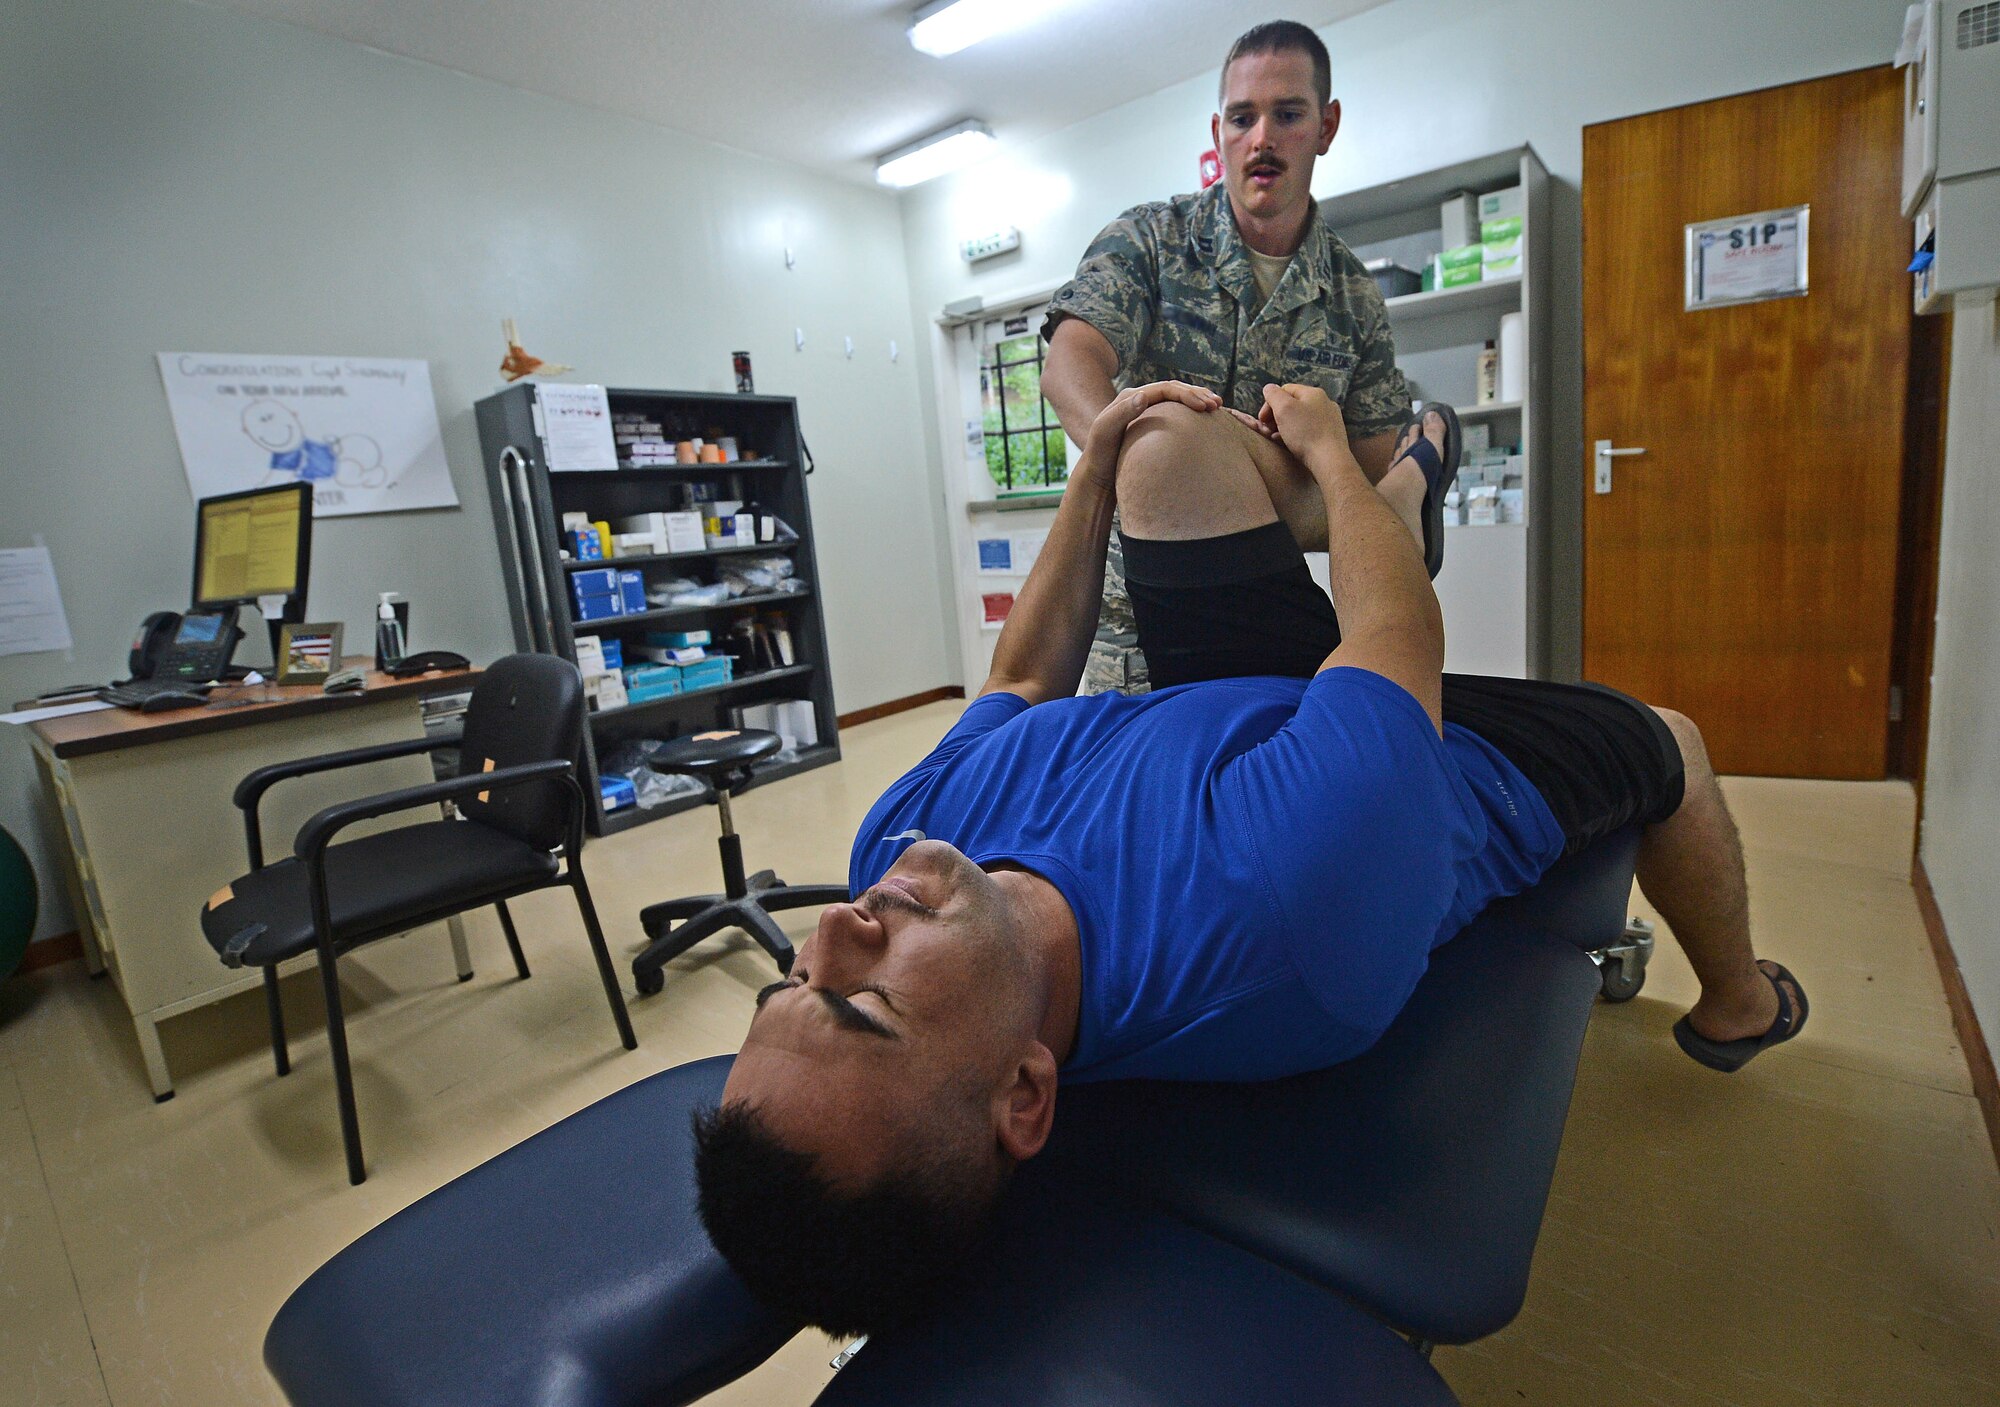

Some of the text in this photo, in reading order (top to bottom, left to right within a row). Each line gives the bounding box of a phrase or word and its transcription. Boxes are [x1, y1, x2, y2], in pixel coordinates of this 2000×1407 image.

[1730, 223, 1777, 248] SIP
[967, 241, 1000, 256] EXIT
[217, 384, 349, 397] ON YOUR NEW ARRIVAL
[314, 491, 346, 506] NTER
[1495, 779, 1518, 816] DRI-FIT
